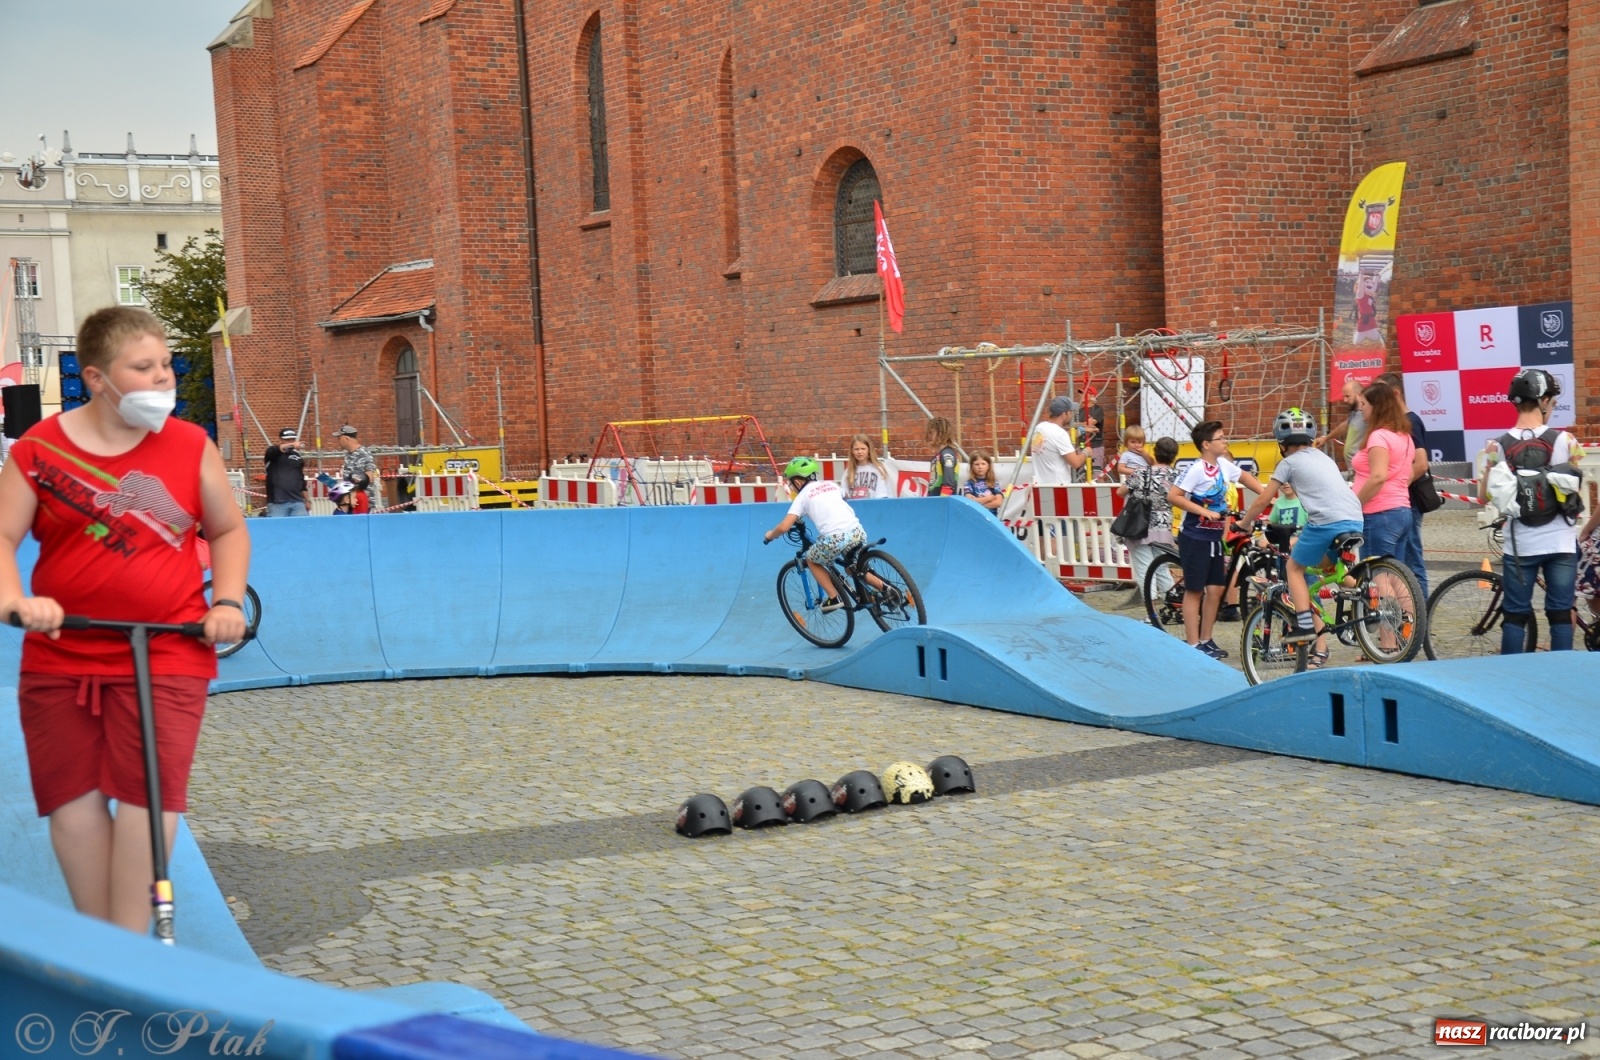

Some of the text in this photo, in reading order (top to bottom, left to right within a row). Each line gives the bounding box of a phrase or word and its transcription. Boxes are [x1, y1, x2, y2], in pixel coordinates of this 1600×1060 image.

[1480, 324, 1493, 342] R
[1537, 340, 1569, 349] RACIBÓRZ
[1413, 349, 1441, 357] RACIBÓRZ
[1468, 392, 1512, 404] RACIBÓR
[1420, 408, 1447, 416] RACIBÓRZ
